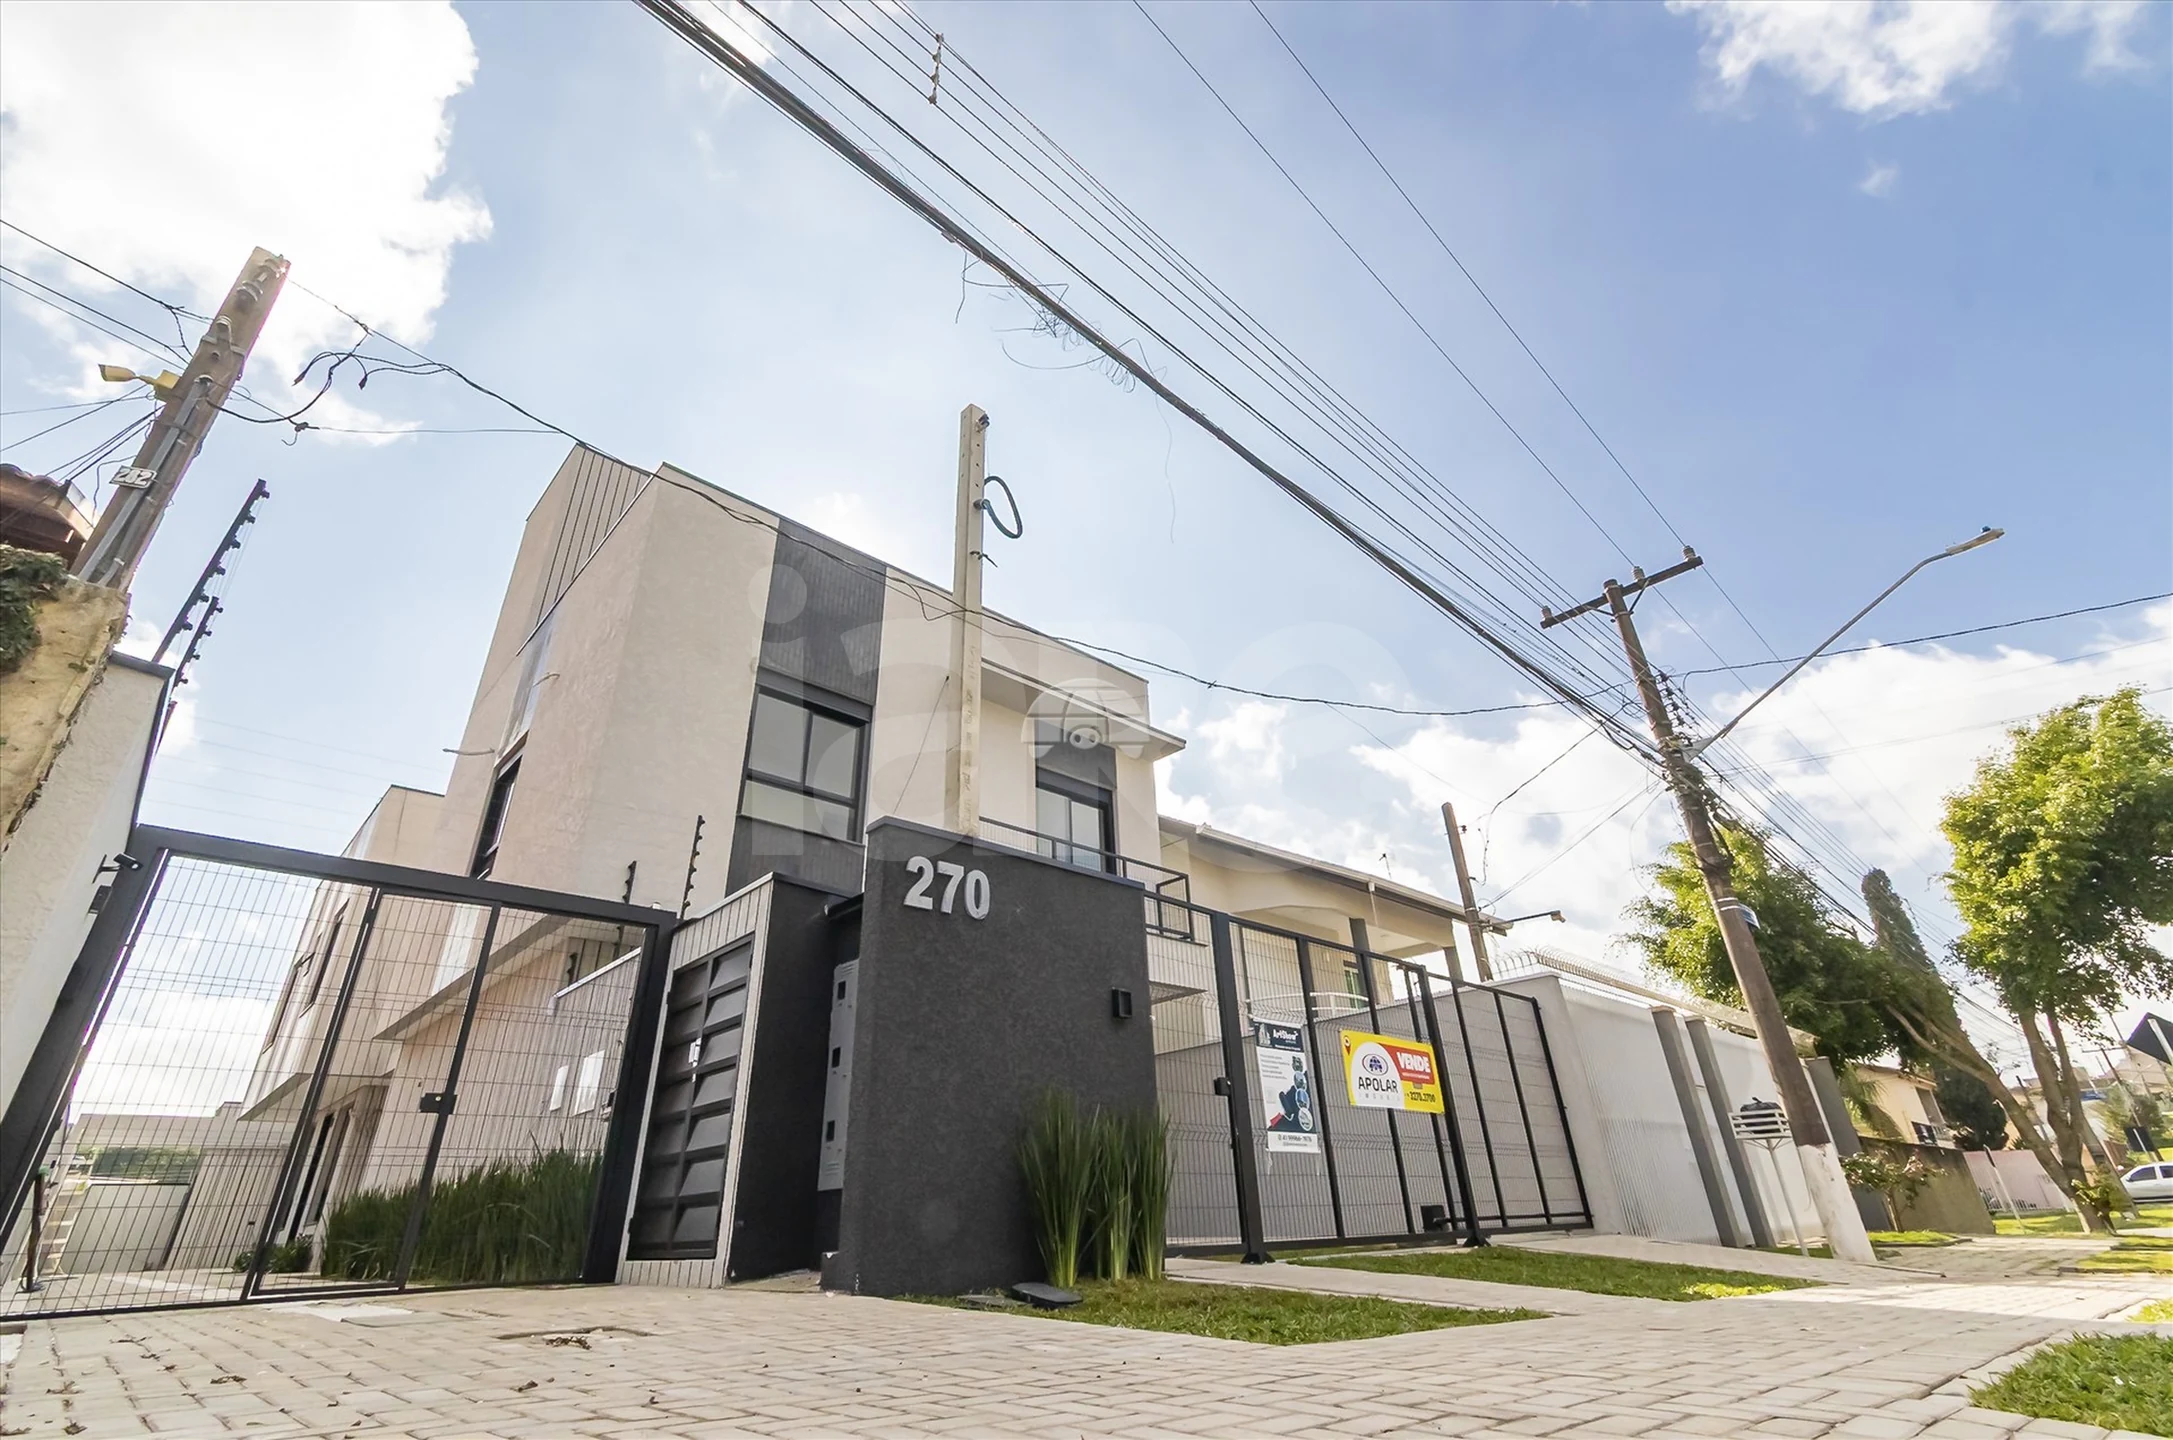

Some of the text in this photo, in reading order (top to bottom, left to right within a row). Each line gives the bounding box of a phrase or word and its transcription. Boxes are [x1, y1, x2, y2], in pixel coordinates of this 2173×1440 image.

[903, 855, 990, 919] 270
[1396, 1052, 1431, 1073] VENDE
[1358, 1076, 1399, 1093] APOLAR
